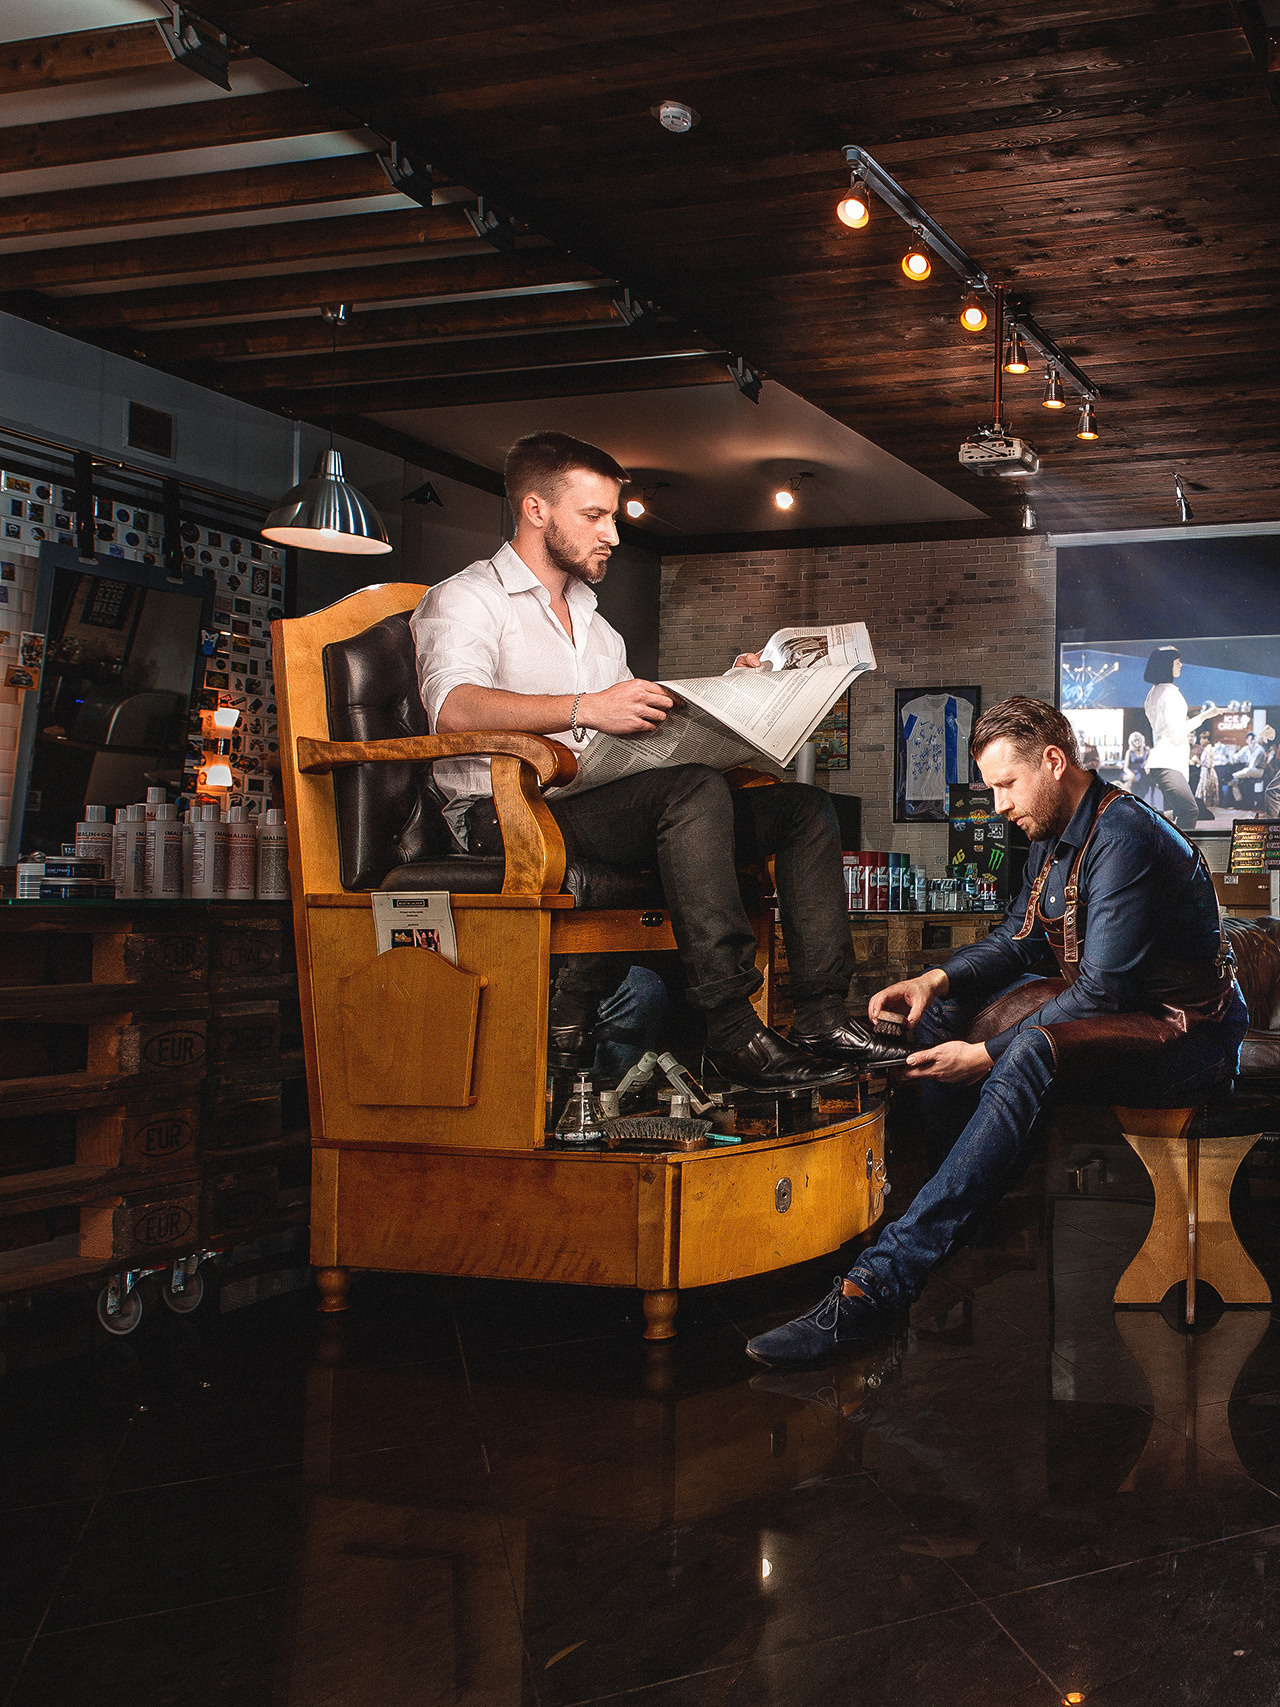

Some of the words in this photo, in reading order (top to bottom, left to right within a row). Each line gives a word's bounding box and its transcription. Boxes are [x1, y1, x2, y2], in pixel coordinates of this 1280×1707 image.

[158, 1037, 194, 1062] EUR
[145, 1124, 181, 1151] EUR
[145, 1212, 181, 1241] EUR
